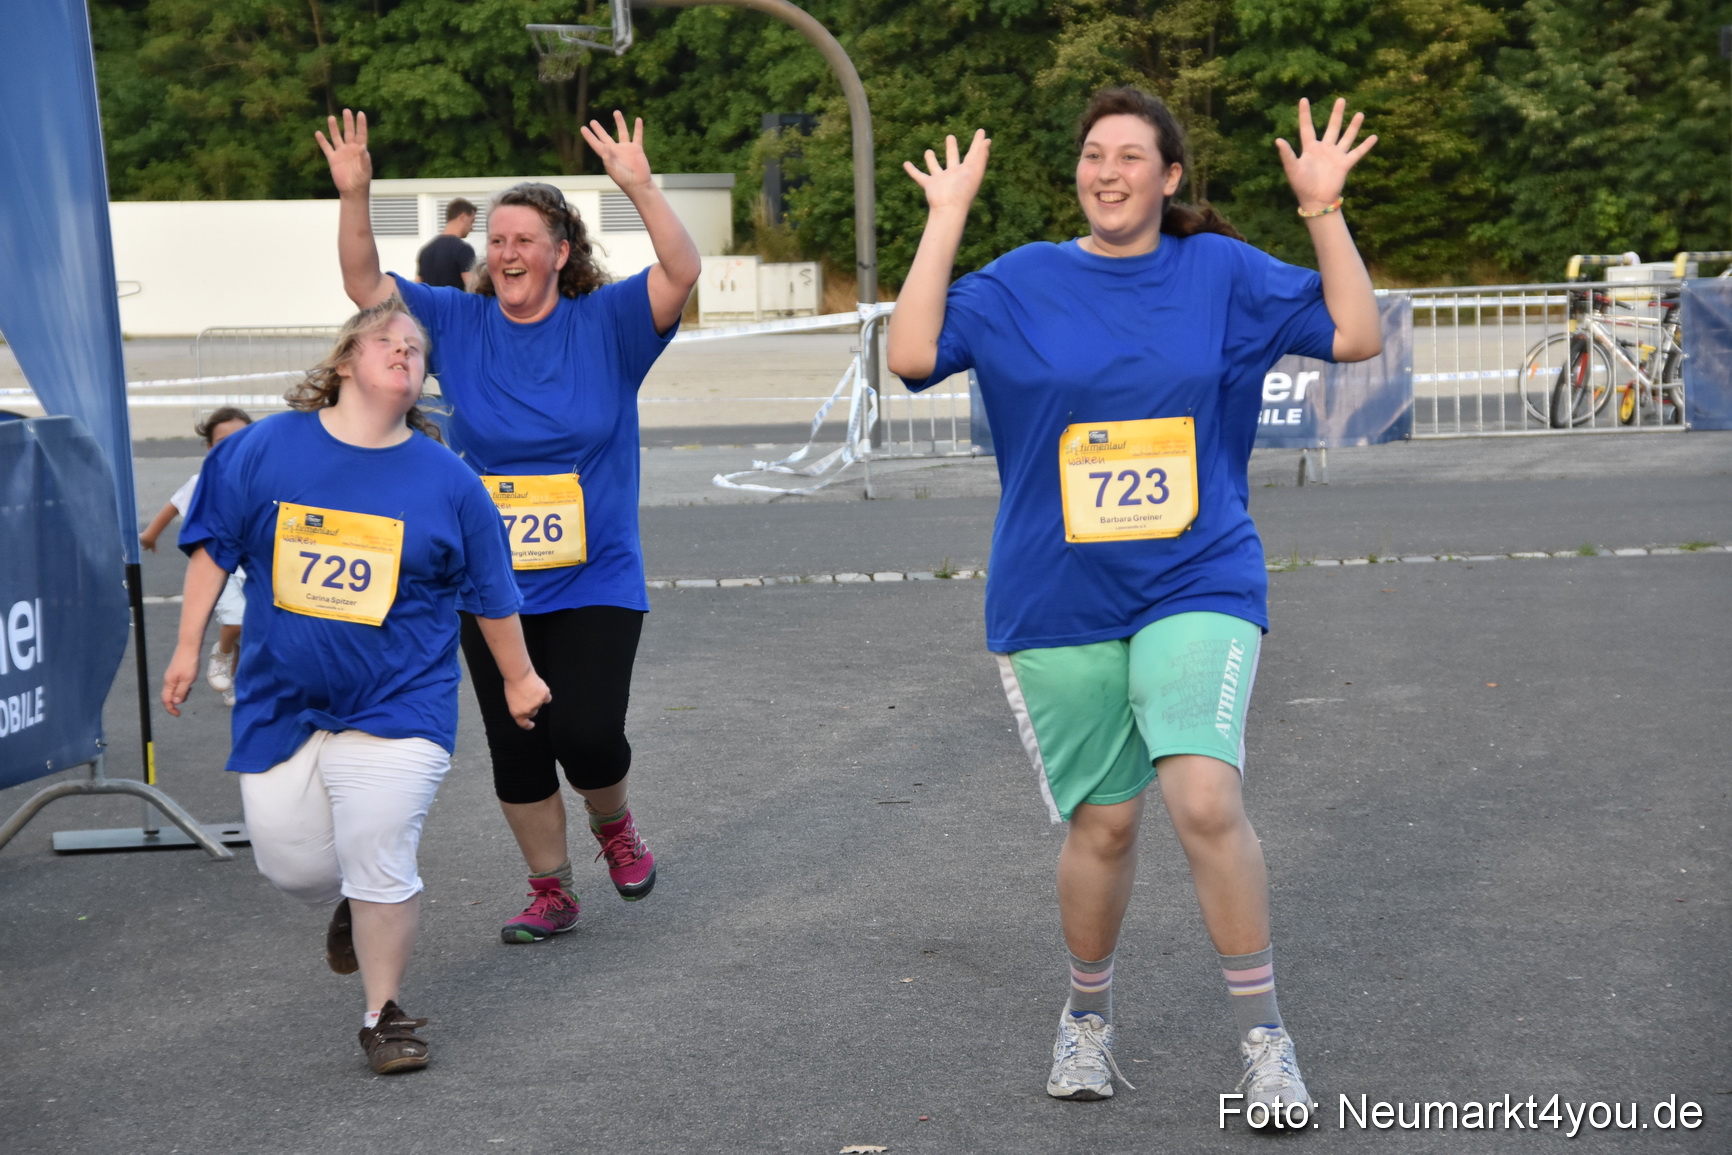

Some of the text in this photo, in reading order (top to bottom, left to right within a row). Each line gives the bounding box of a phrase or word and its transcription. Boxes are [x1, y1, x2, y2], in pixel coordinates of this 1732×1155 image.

[1257, 408, 1303, 425] ILE
[1080, 440, 1127, 452] firmenlauf
[1068, 456, 1105, 466] walken
[1088, 467, 1170, 508] 723
[492, 491, 528, 499] firmenlauf
[1100, 514, 1162, 523] Barbara Greiner
[296, 524, 340, 536] firmenlauf
[501, 513, 563, 543] 726
[282, 534, 316, 545] walken
[299, 550, 372, 592] 729
[306, 593, 357, 606] Carina Spitzer
[1215, 638, 1245, 739] ATHLETIC
